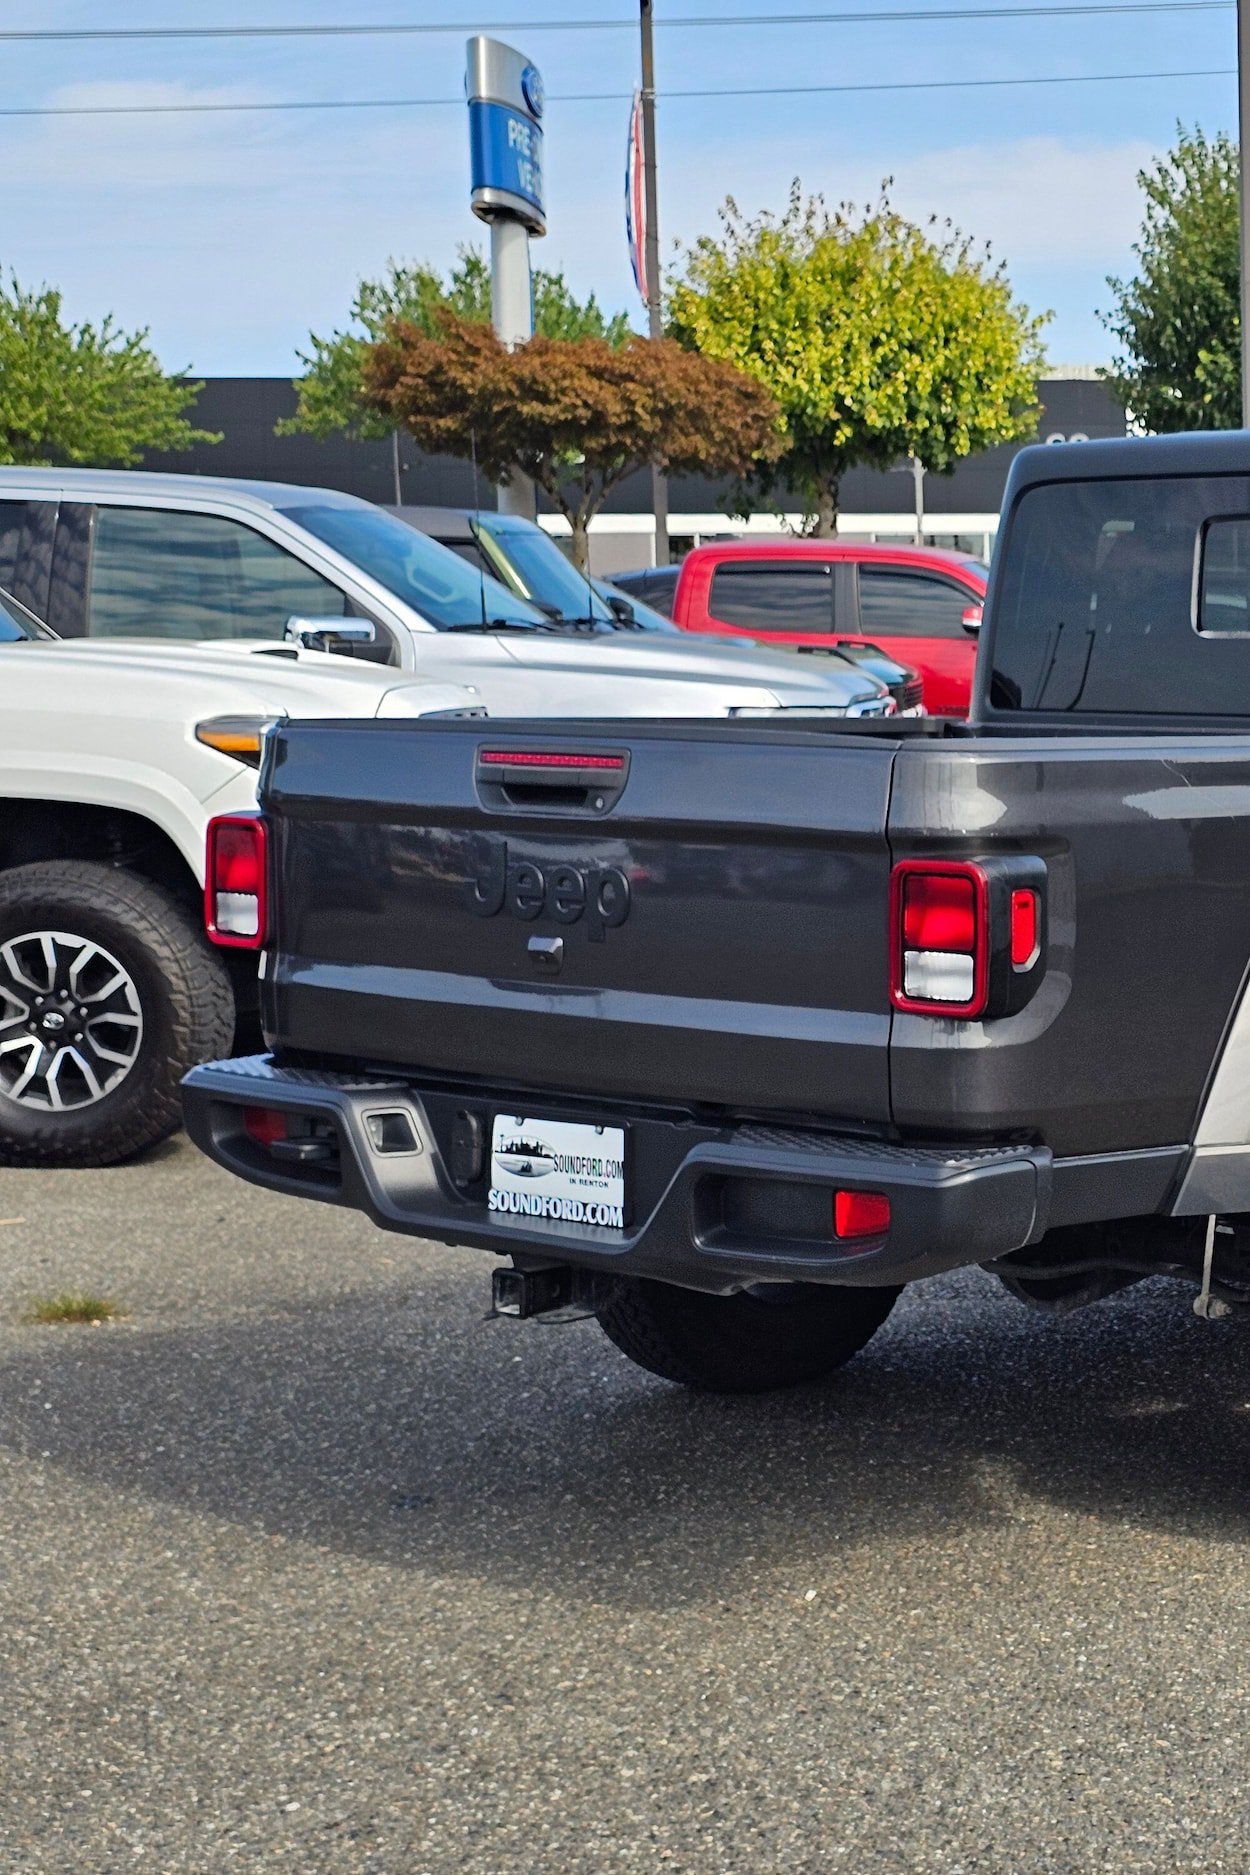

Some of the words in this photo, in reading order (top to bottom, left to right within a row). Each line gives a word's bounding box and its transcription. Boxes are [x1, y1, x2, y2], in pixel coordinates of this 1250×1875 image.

[472, 840, 632, 943] Jeep
[553, 1153, 624, 1180] SOUNDFORD.COM
[488, 1188, 624, 1228] SOUNDFORD.COM
